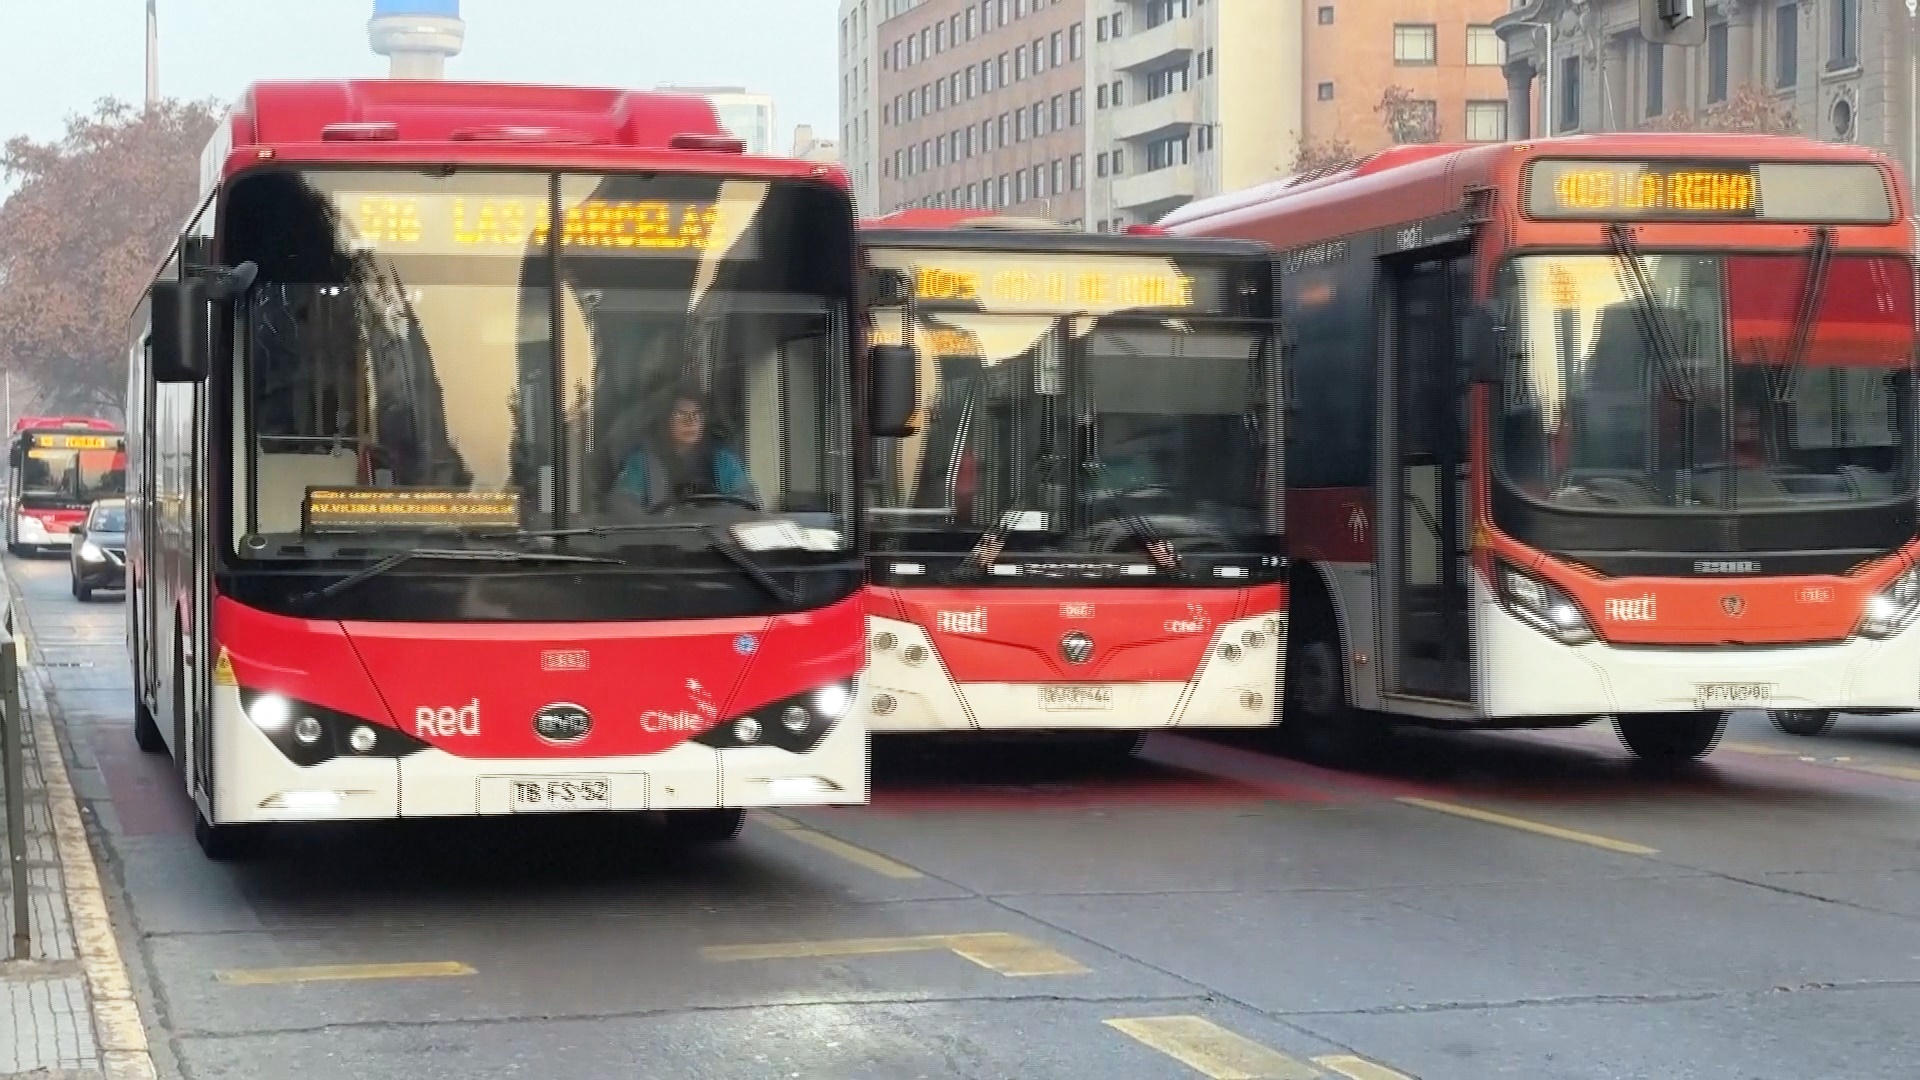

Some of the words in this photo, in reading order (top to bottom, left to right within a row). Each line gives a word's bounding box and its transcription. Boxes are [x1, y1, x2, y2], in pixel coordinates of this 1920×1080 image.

[1554, 171, 1614, 210] 403
[1618, 172, 1663, 210] LA
[1666, 173, 1756, 211] REINA
[453, 200, 526, 245] LAS
[937, 605, 987, 633] Red
[1605, 593, 1657, 621] Red
[415, 697, 480, 737] Red
[537, 714, 588, 733] BYD
[640, 709, 704, 734] Chile
